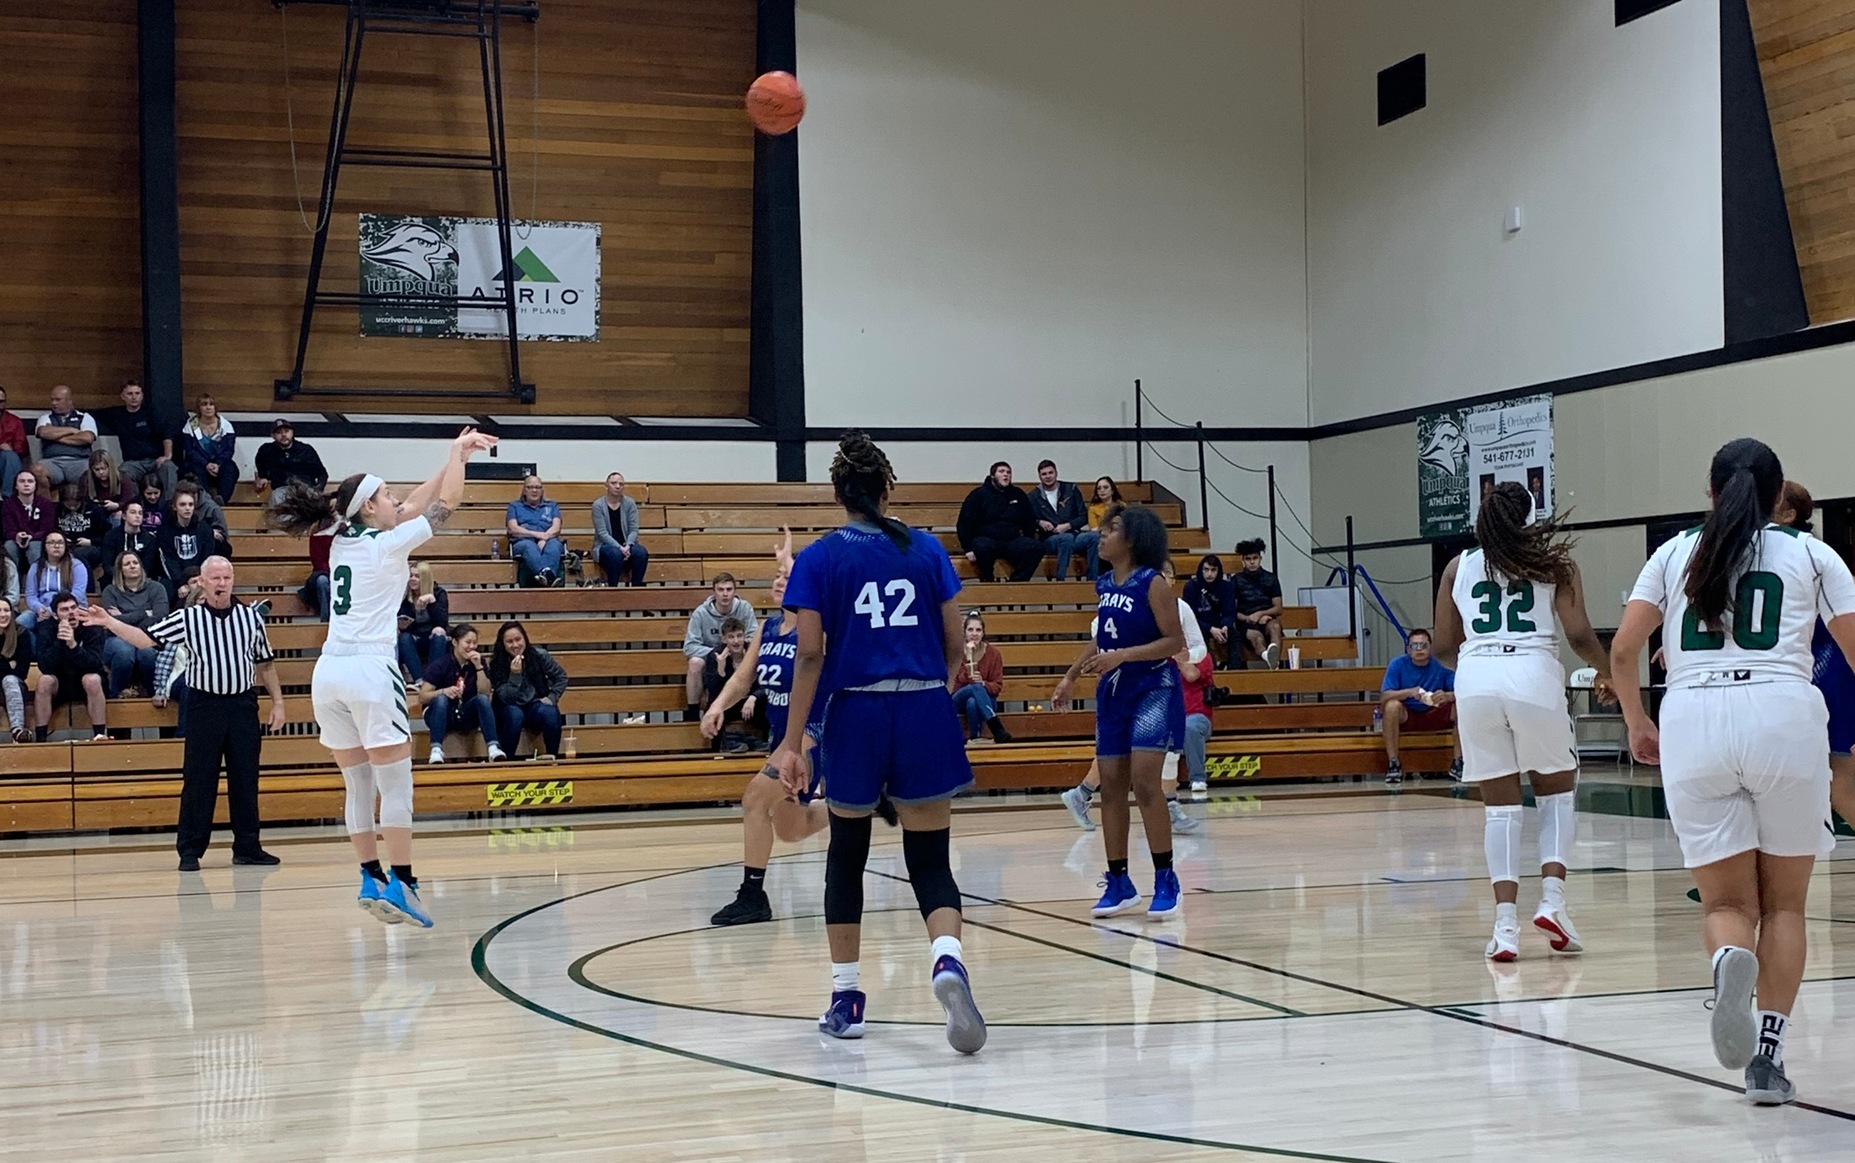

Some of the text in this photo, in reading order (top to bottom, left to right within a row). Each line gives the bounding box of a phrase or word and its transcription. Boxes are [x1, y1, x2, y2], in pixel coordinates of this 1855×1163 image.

[365, 275, 454, 296] Umpqua
[471, 286, 579, 305] ATRIO
[375, 315, 446, 325] uccriverhawks.com
[1469, 412, 1548, 435] Umpqua Orthopedics
[1483, 447, 1535, 464] 541-677-2131
[1420, 475, 1467, 496] Umpqua
[1428, 494, 1460, 507] ATHLETICS
[333, 565, 352, 615] 3
[854, 578, 918, 629] 42
[1471, 580, 1536, 634] 32
[1104, 617, 1118, 639] 4
[757, 664, 782, 686] 22
[491, 788, 570, 799] WATCH YOUR STEP
